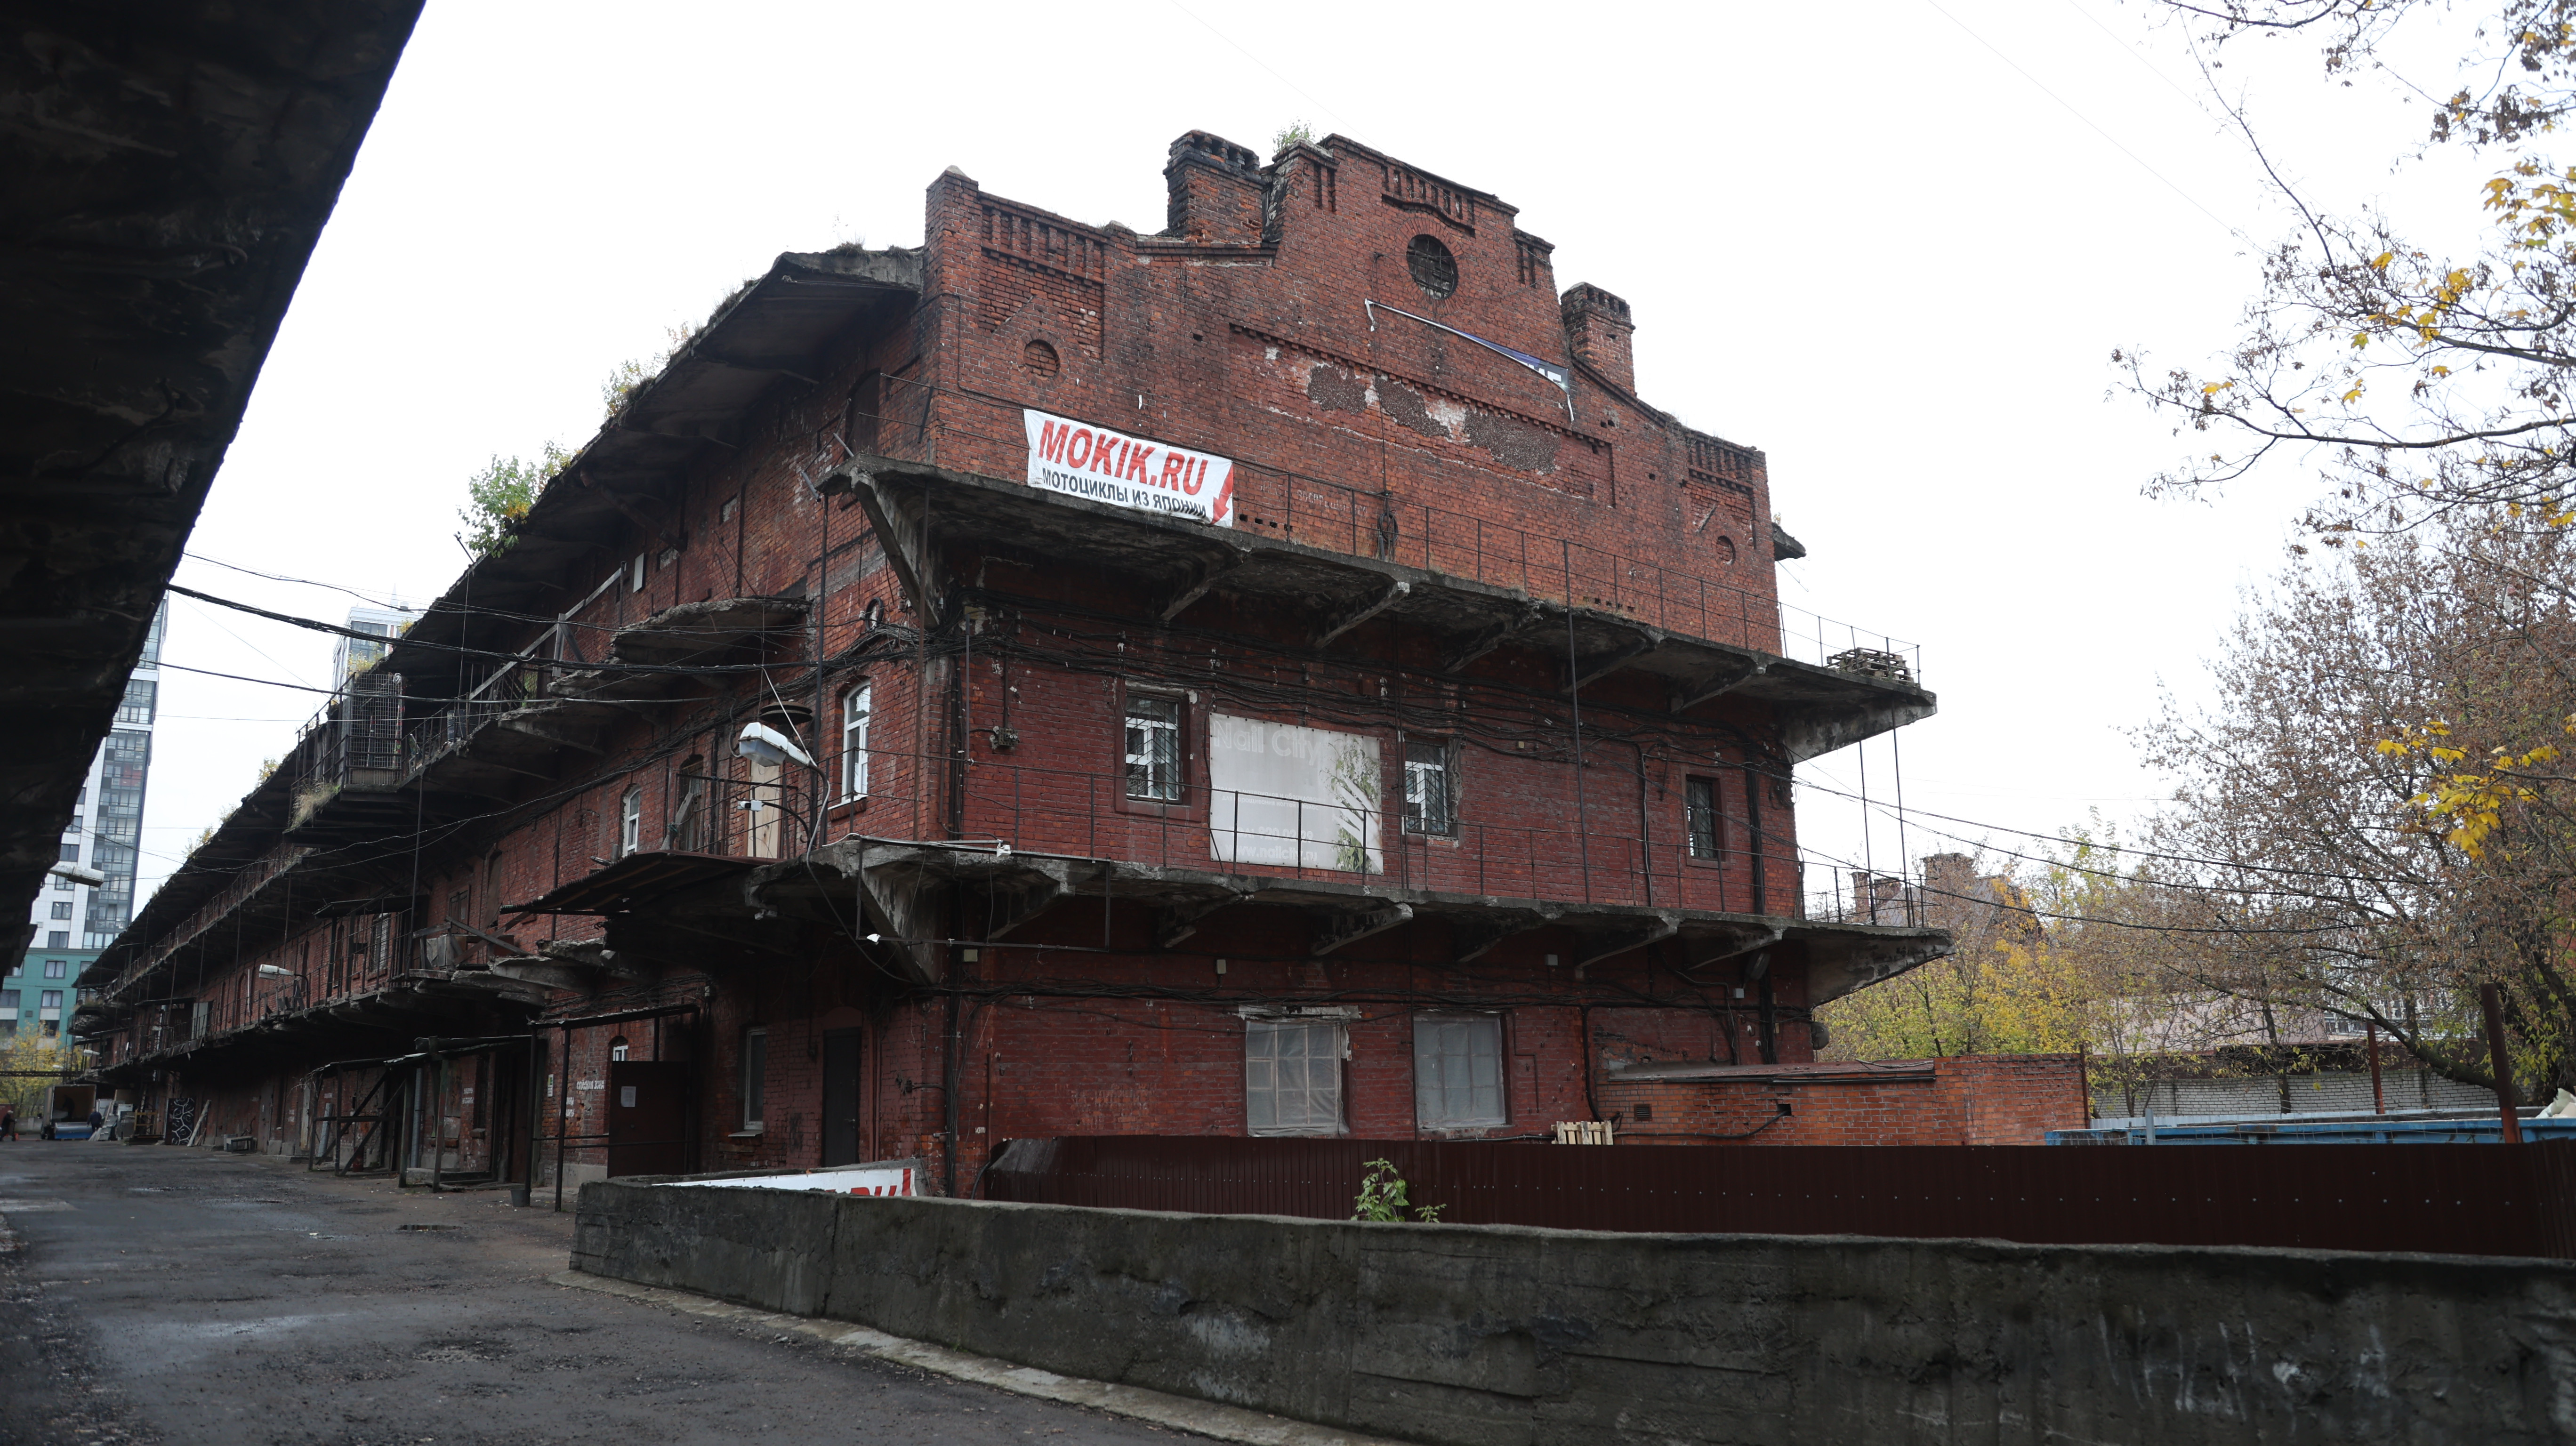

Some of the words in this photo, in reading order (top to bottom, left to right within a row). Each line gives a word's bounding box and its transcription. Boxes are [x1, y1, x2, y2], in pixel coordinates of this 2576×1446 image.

[1038, 419, 1208, 496] MOKIK.RU
[1043, 467, 1129, 503] МОТОЦИКЛЫ
[1133, 489, 1149, 506] ИЗ
[1154, 494, 1207, 518] ЯПОНИИ
[1214, 720, 1264, 754] Nail
[1272, 730, 1322, 766] City
[1258, 826, 1279, 840] 920
[1283, 828, 1297, 842] 02
[1301, 830, 1313, 843] 29
